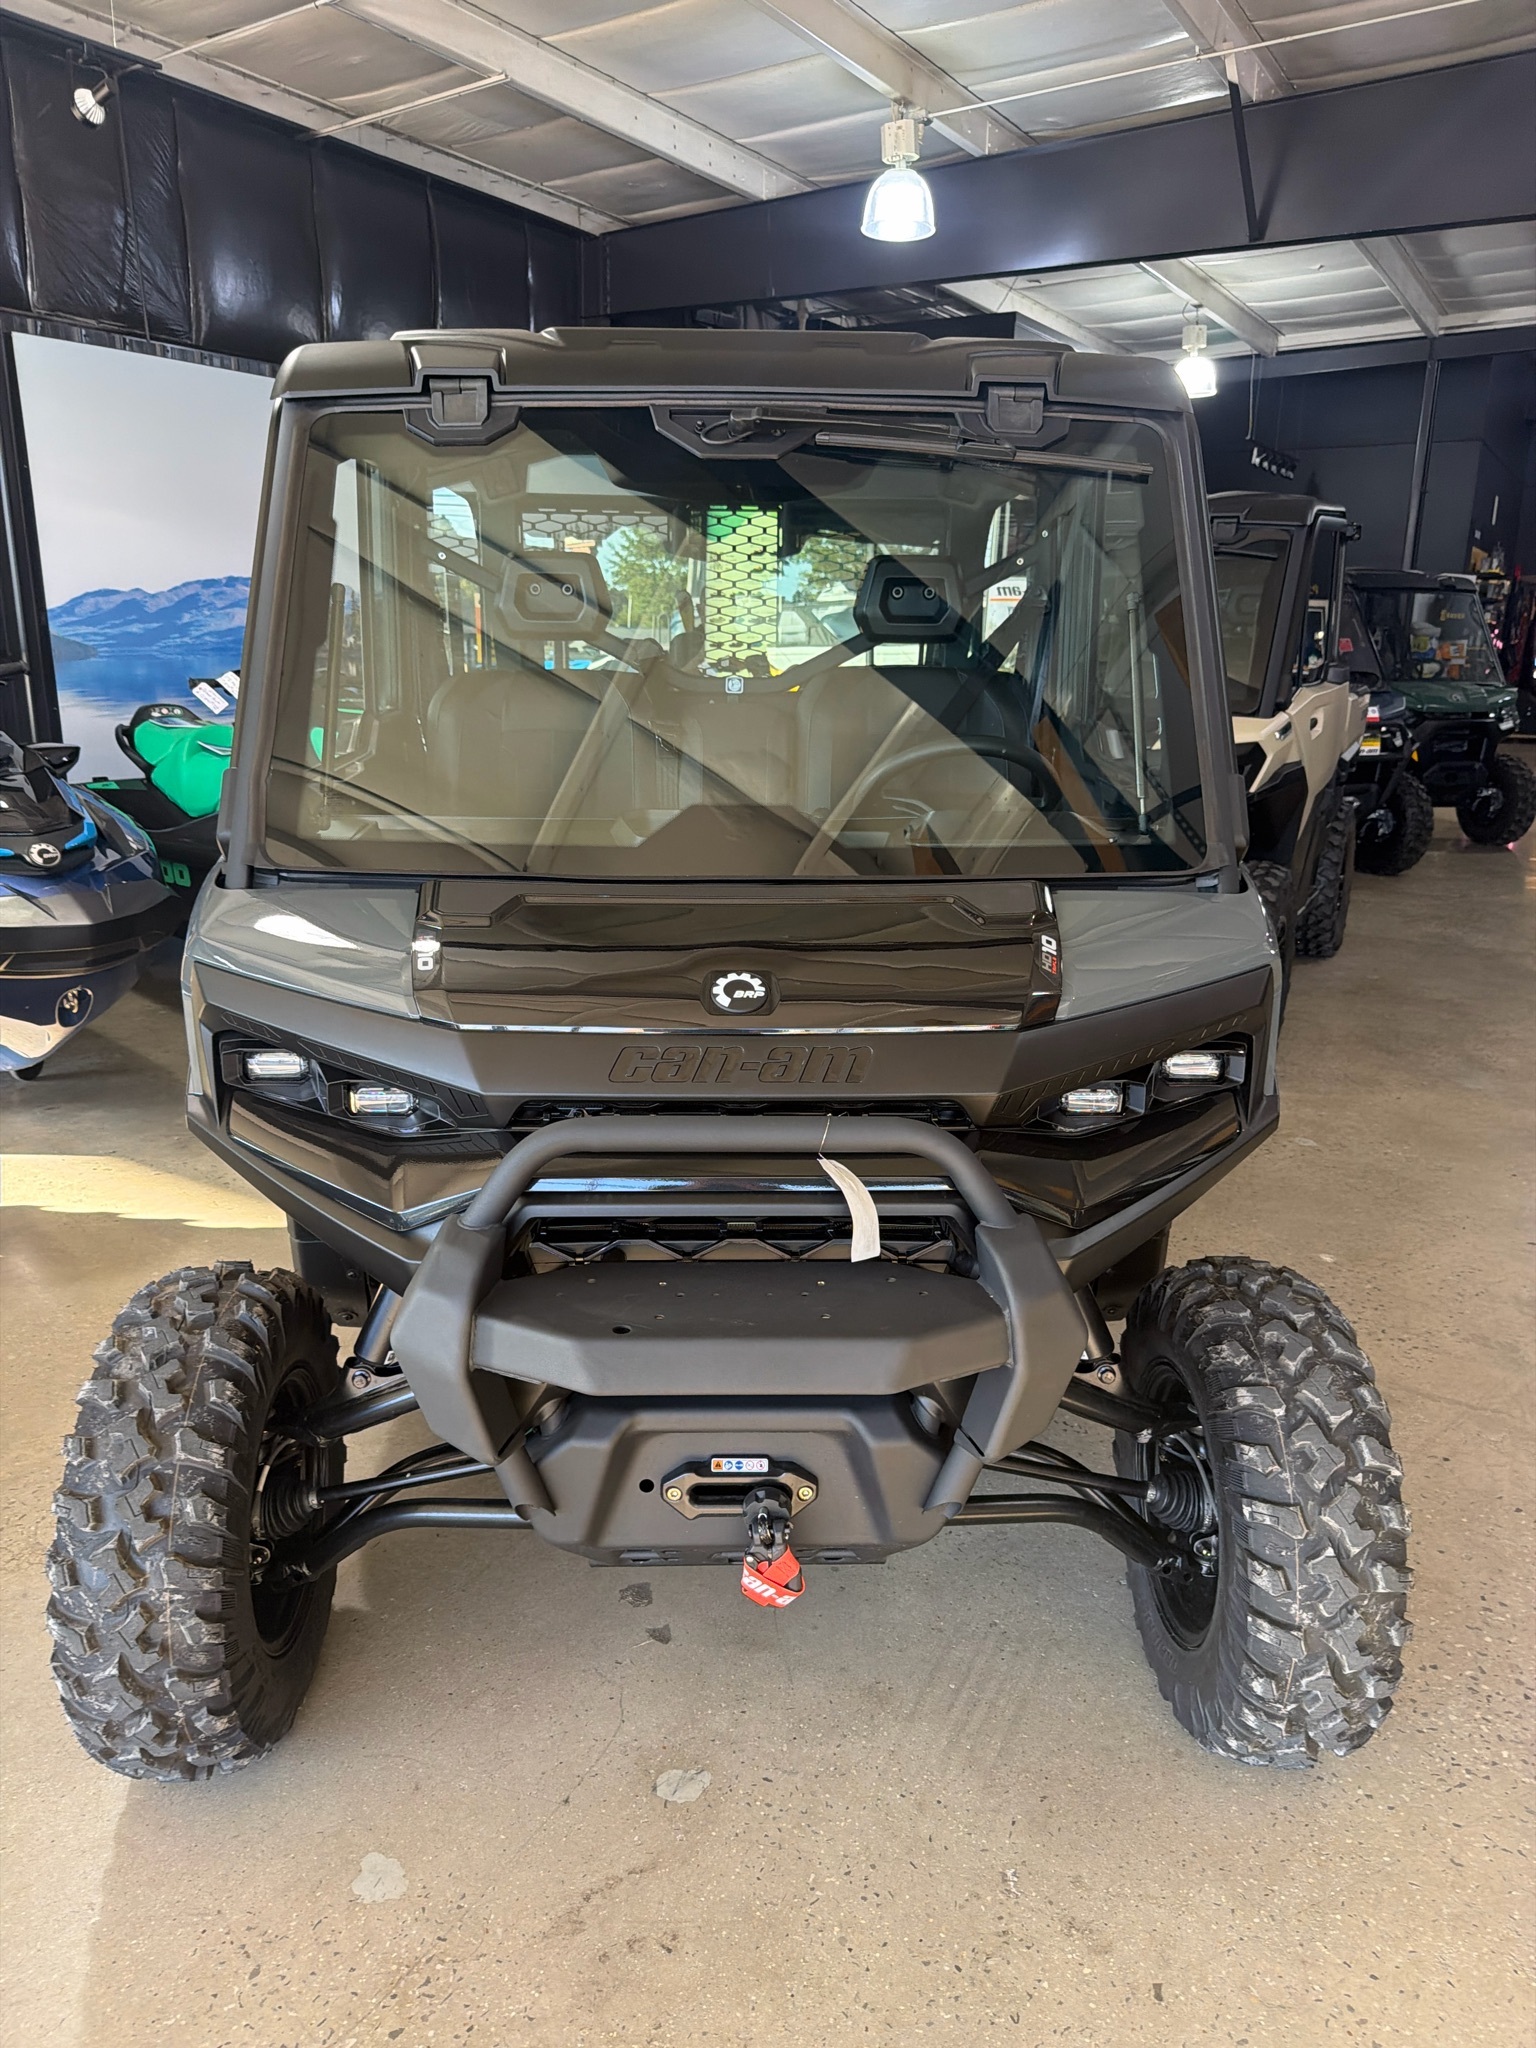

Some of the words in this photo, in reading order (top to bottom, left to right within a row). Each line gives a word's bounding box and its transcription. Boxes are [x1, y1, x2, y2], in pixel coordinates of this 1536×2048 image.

[1041, 934, 1057, 973] HD10
[733, 990, 765, 998] BRP
[608, 1045, 873, 1083] can-am
